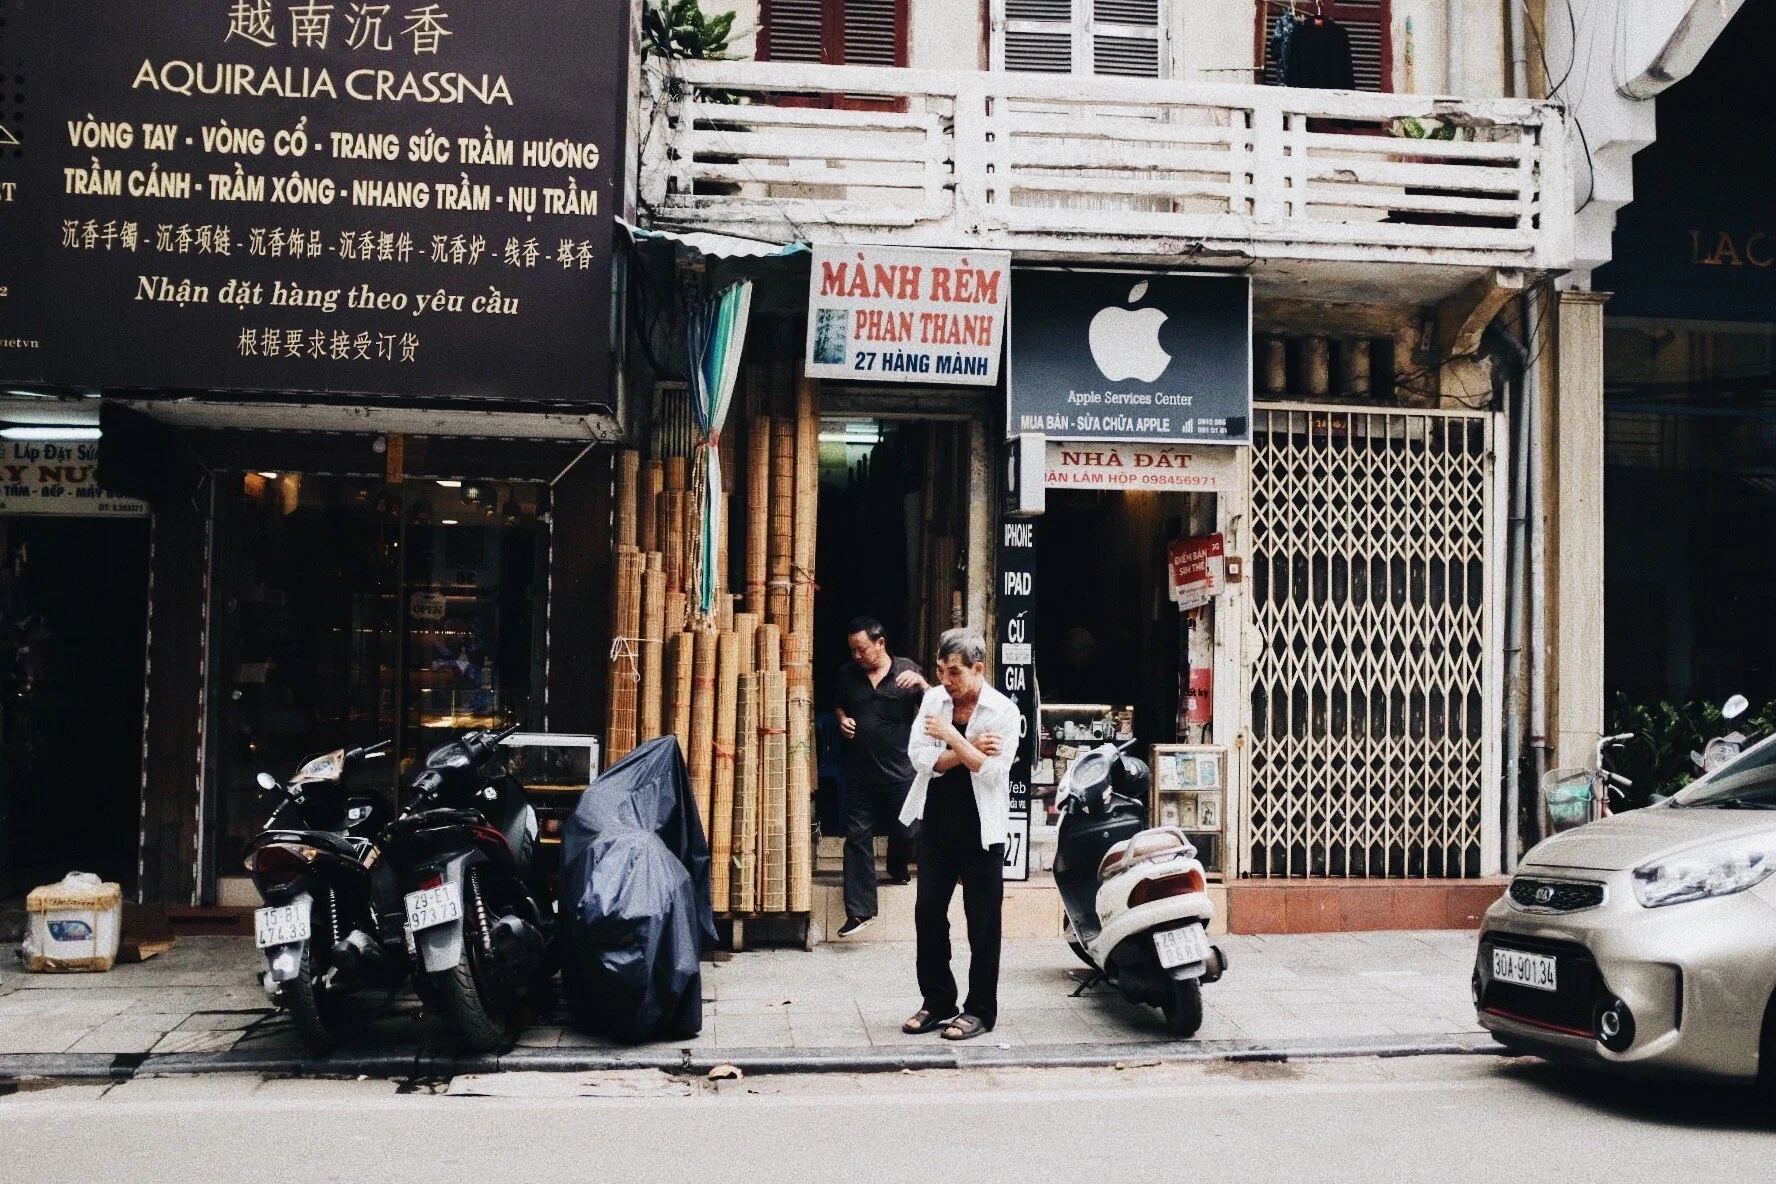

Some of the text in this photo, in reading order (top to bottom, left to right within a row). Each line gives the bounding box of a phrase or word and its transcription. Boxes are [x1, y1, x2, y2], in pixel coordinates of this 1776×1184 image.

[223, 0, 453, 55] 越南沉香
[132, 59, 514, 106] AQUIRALIA CRASSNA
[68, 113, 133, 148] VÒNG
[142, 123, 177, 150] TAY
[202, 118, 265, 155] VÒNG
[274, 115, 307, 156] CỔ
[330, 132, 399, 160] TRANG
[408, 127, 450, 163] SỨC
[458, 125, 513, 165] TRẦM
[523, 138, 599, 169] HƯƠNG
[64, 155, 122, 196] TRẦM
[128, 161, 190, 198] CẢNH
[209, 161, 264, 202] TRẦM
[270, 171, 335, 205] XÔNG
[353, 180, 429, 208] NHANG
[435, 172, 490, 211] TRẦM
[508, 186, 536, 222] NỤ
[543, 176, 598, 216] TRẦM
[62, 219, 138, 252] 沉香手镯
[156, 223, 231, 256] 沉香项链
[249, 227, 322, 259] 沉香饰品
[339, 230, 413, 263] 沉香摆件
[430, 234, 486, 266] 沉香炉
[504, 237, 540, 267] 线香
[557, 239, 594, 269] 塔香
[135, 276, 519, 316] Nhận đặt hàng theo yêu cầu
[854, 309, 994, 346] PHAN THANH
[237, 327, 420, 363] 根据要求接受订货
[854, 351, 876, 371] 27
[882, 348, 929, 374] HÀNG
[1068, 390, 1193, 406] Apple Services Center
[1020, 415, 1044, 430] MUA
[1046, 412, 1069, 430] BÁN
[1077, 412, 1100, 431] SỬA
[1136, 417, 1171, 432] APPLE
[1061, 447, 1192, 468] NHÀ ĐẤT
[1142, 474, 1216, 486] 098456971
[1004, 523, 1033, 548] IPHONE
[1004, 571, 1031, 596] IPAD
[413, 604, 442, 614] OPEN
[1003, 832, 1020, 867] 27
[413, 887, 449, 910] 29-E1
